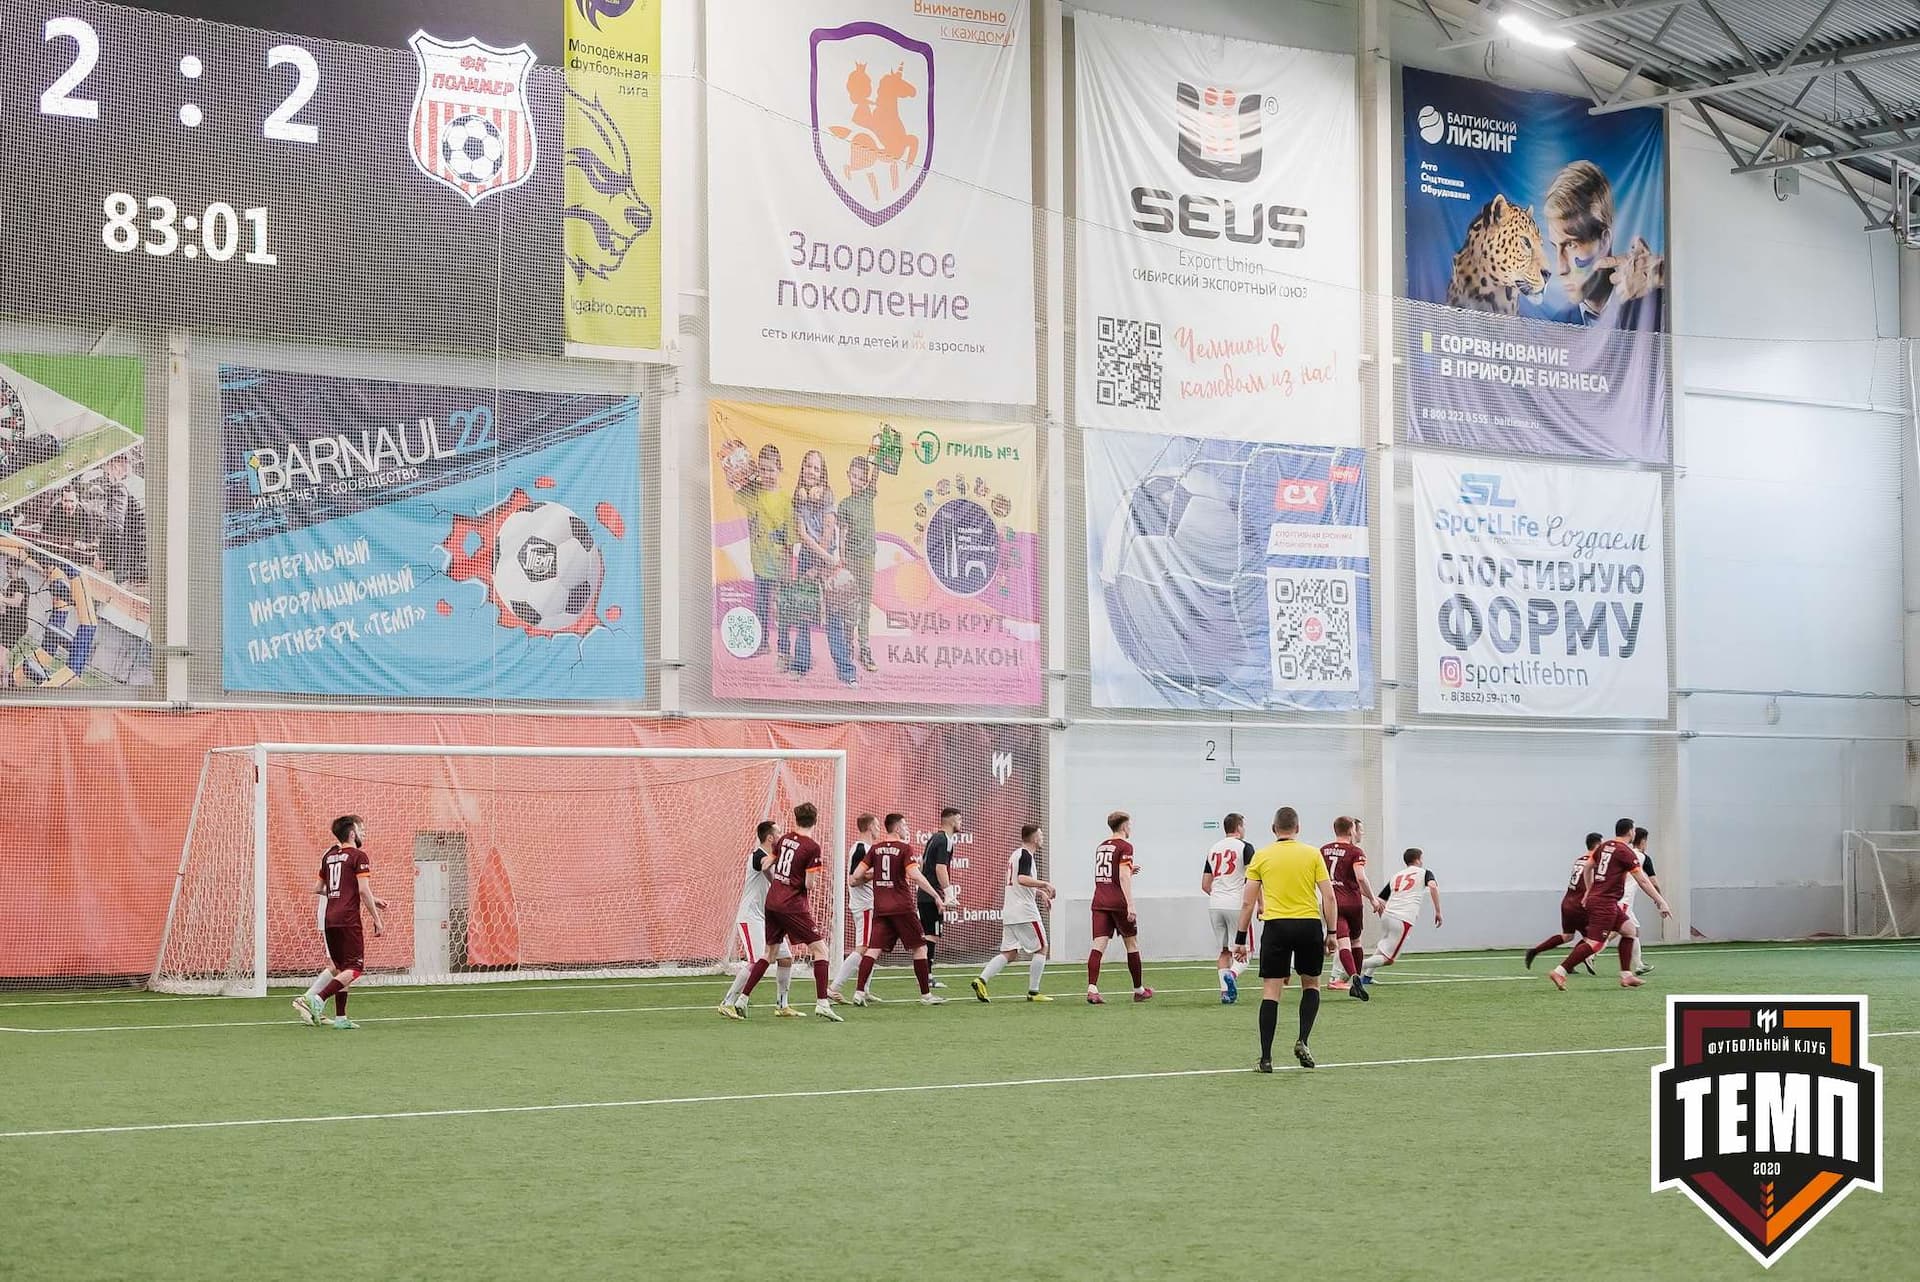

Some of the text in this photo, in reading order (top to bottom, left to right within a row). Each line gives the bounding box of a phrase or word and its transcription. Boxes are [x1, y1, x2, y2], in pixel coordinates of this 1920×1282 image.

[914, 0, 1006, 23] Внимательно
[460, 55, 487, 72] ФК
[568, 38, 648, 64] Молодёжная
[40, 16, 100, 120] 2
[263, 44, 319, 144] 2
[570, 56, 648, 80] футбольная
[432, 73, 515, 97] ПОЛИМЕР
[618, 84, 648, 98] лига
[1447, 111, 1517, 134] БАЛТИЙСКИЙ
[1447, 125, 1517, 154] ЛИЗИНГ
[101, 191, 277, 266] 83:01
[1131, 186, 1308, 249] SEUS
[789, 230, 956, 278] Здоровое
[1179, 250, 1264, 275] Export Union
[1132, 268, 1308, 299] СИБИРСКИЙ ЭКСПОРТНЫЙ СОЮЗ
[570, 295, 648, 318] ligabro.com
[777, 279, 970, 320] поколение
[761, 326, 788, 339] сеть
[791, 330, 835, 345] клиник
[838, 333, 860, 348] для
[863, 335, 899, 350] детей
[902, 338, 909, 350] и
[929, 340, 985, 353] взрослых
[1174, 323, 1287, 363] Чемпион в
[1440, 334, 1570, 366] СОРЕВНОВАНИЕ
[1179, 363, 1264, 399] каждом
[1272, 369, 1294, 397] из
[1440, 358, 1610, 393] В ПРИРОДЕ БИЗНЕСА
[946, 441, 1020, 461] ГРИЛЬ №1
[331, 467, 419, 495] СООБЩЕСТВО
[1435, 509, 1540, 537] SportLife
[1546, 514, 1650, 559] Создаем
[247, 536, 371, 585] ГЕНЕРАЛЬНЫЙ
[1437, 552, 1645, 594] СПОРТИВНУЮ
[248, 564, 416, 627] ИНФОРМАЦИОННЫЙ
[247, 604, 427, 665] ПАРТНЕР ФК «ТЕМП»
[886, 610, 950, 634] БУДЬ
[1438, 593, 1643, 658] ФОРМУ
[887, 645, 1023, 669] КАК ДРАКОН!
[1465, 660, 1589, 689] sportlifebrn
[1205, 739, 1217, 762] 2
[777, 846, 795, 877] 18
[881, 854, 891, 881] 9
[1095, 851, 1112, 878] 25
[1329, 855, 1339, 881] 7
[328, 862, 342, 891] 10
[1393, 871, 1418, 893] 15
